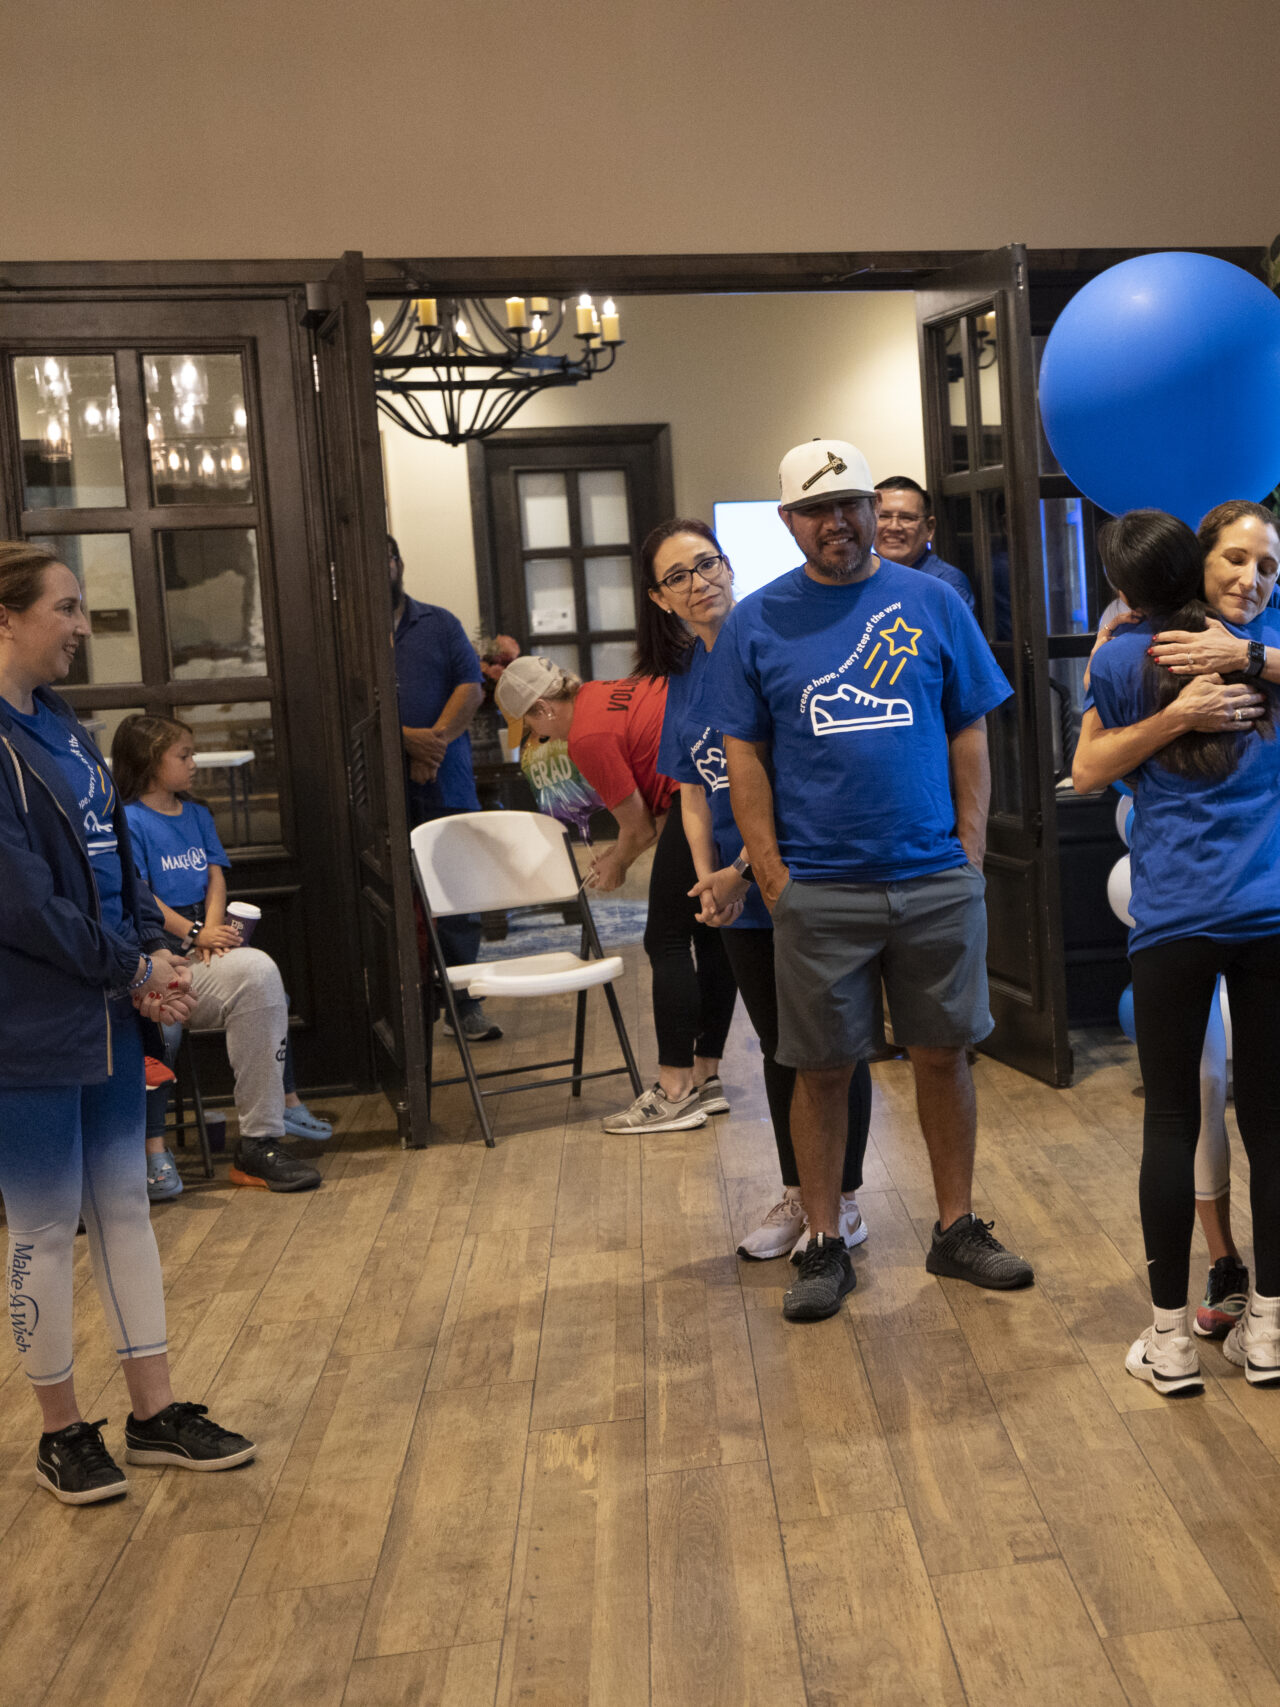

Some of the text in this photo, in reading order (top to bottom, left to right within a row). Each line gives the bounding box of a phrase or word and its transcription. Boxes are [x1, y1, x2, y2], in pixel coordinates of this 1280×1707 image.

[800, 601, 902, 714] create hope, every step of the way
[530, 753, 572, 790] GRAD
